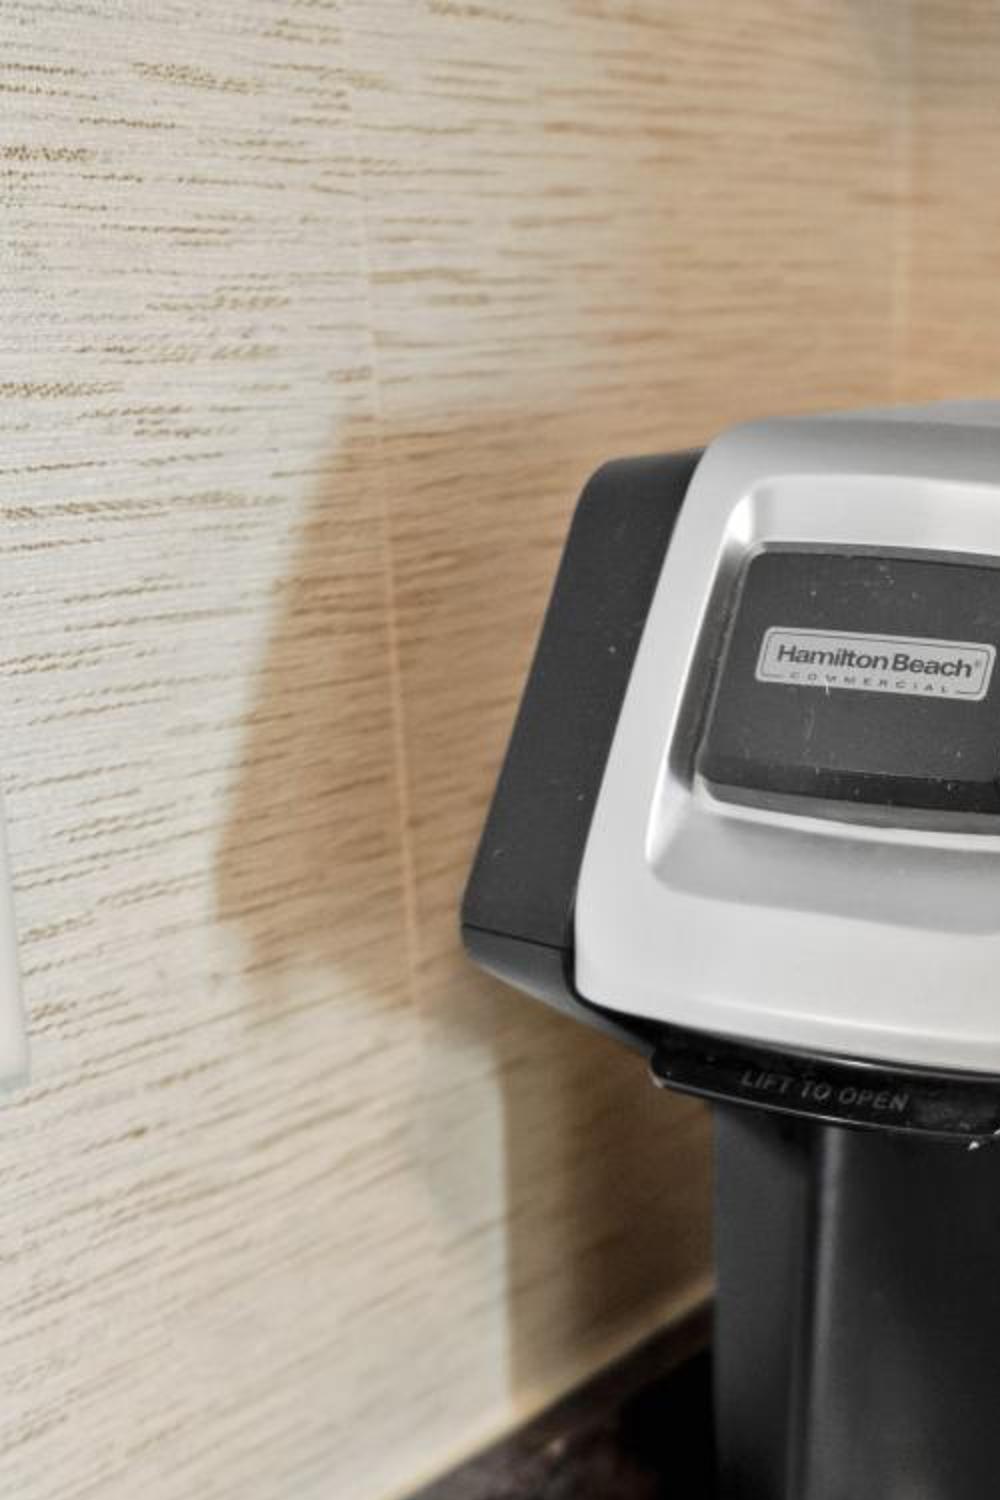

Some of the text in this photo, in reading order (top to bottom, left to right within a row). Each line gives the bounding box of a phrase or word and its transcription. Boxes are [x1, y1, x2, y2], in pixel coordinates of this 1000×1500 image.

[776, 643, 973, 679] Hamilton Beach
[789, 670, 949, 695] COMMERCIAL
[740, 1072, 910, 1113] LIFT TO OPEN
